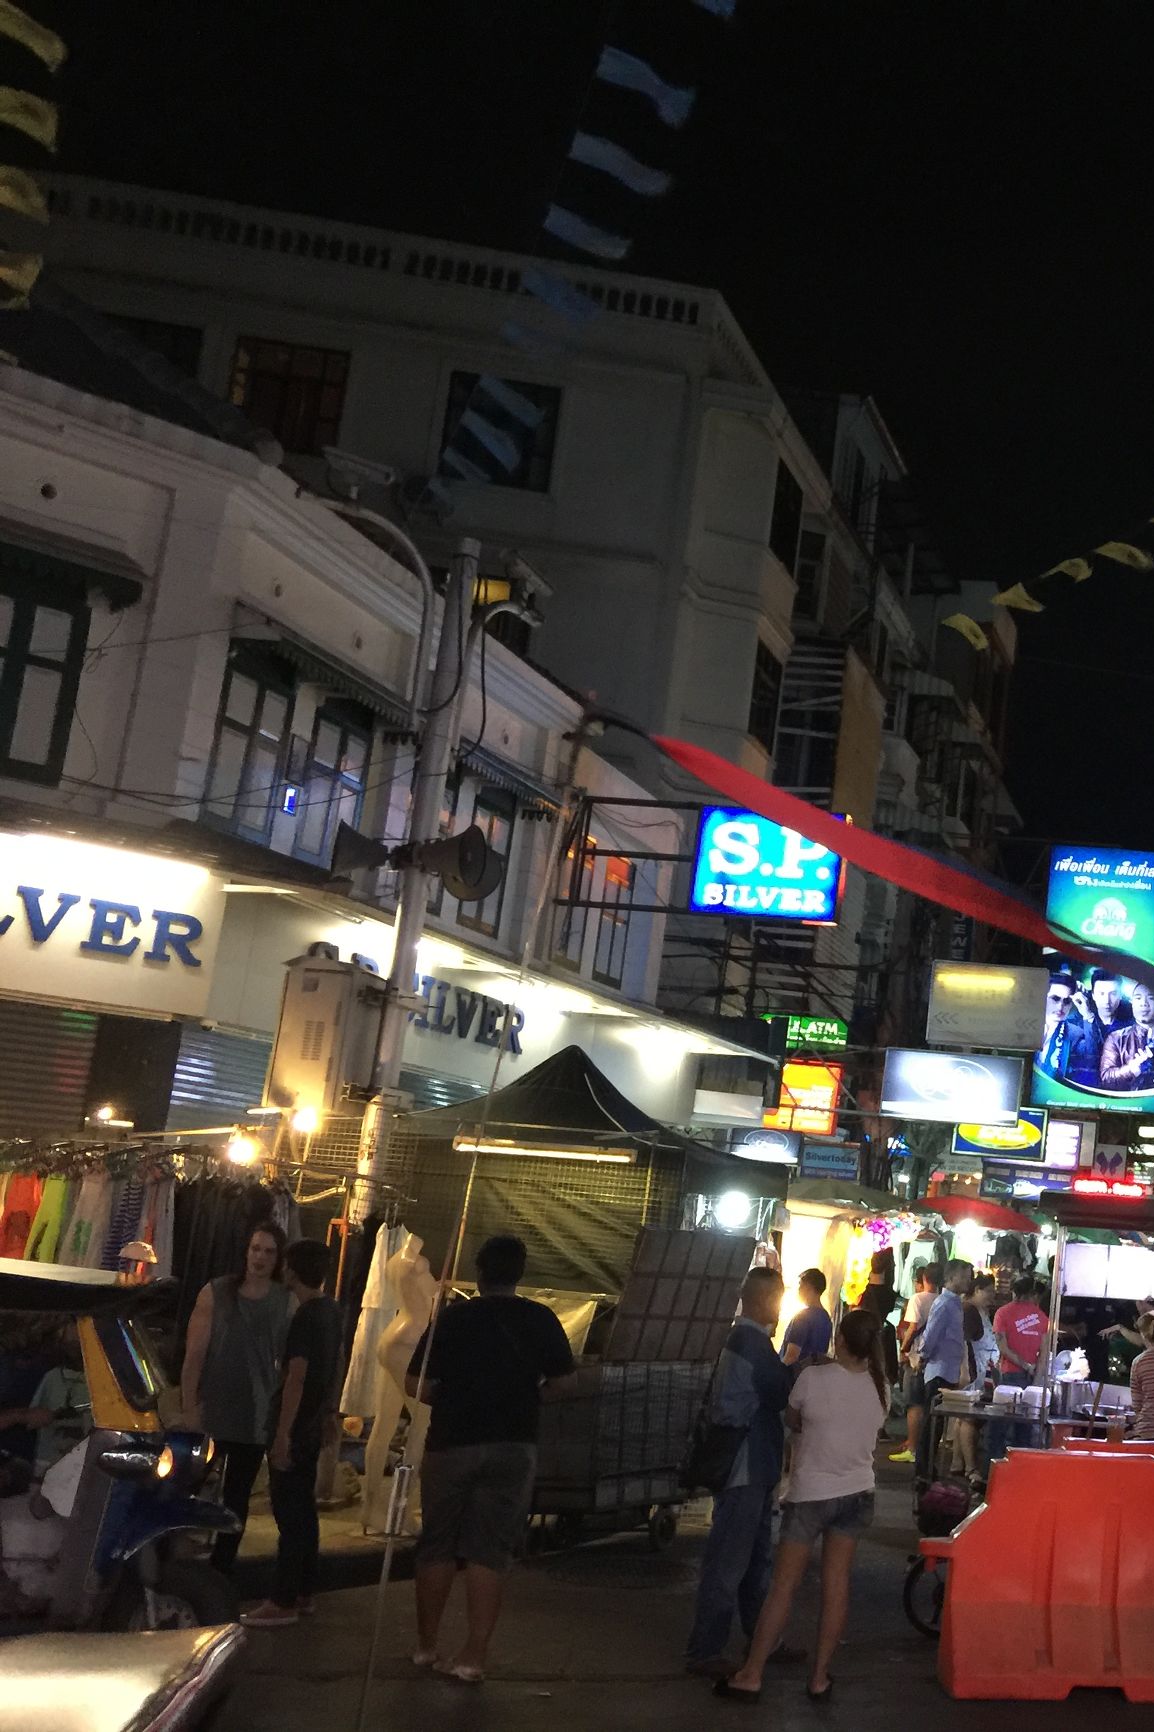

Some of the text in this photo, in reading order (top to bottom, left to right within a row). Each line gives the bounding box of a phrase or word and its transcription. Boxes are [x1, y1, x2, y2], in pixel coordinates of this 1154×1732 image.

[709, 821, 830, 880] S.P.
[703, 883, 826, 912] SILVER
[0, 885, 203, 967] VER
[1081, 918, 1136, 941] Chang
[407, 973, 524, 1054] ILVER
[807, 1022, 838, 1035] ATM
